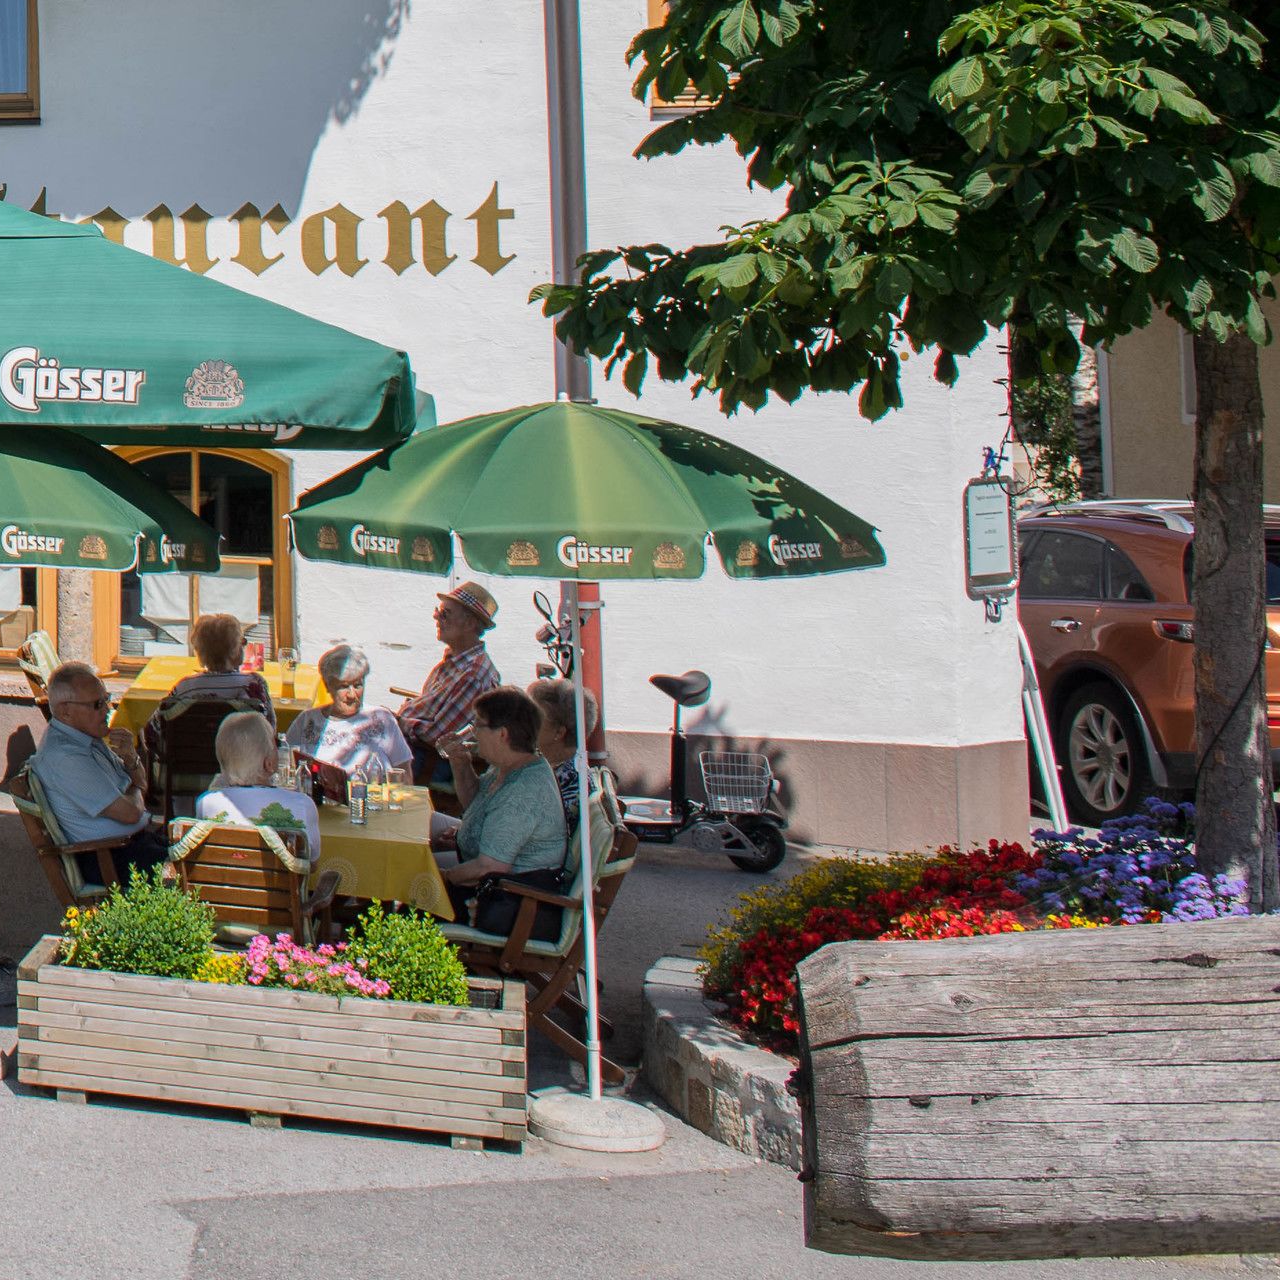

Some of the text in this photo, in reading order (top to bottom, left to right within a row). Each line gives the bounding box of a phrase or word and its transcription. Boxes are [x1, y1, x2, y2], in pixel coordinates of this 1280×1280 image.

[1, 524, 65, 556] Gösser
[351, 523, 400, 555] Gösser
[556, 535, 634, 569] Gösser
[768, 534, 823, 567] Gösser
